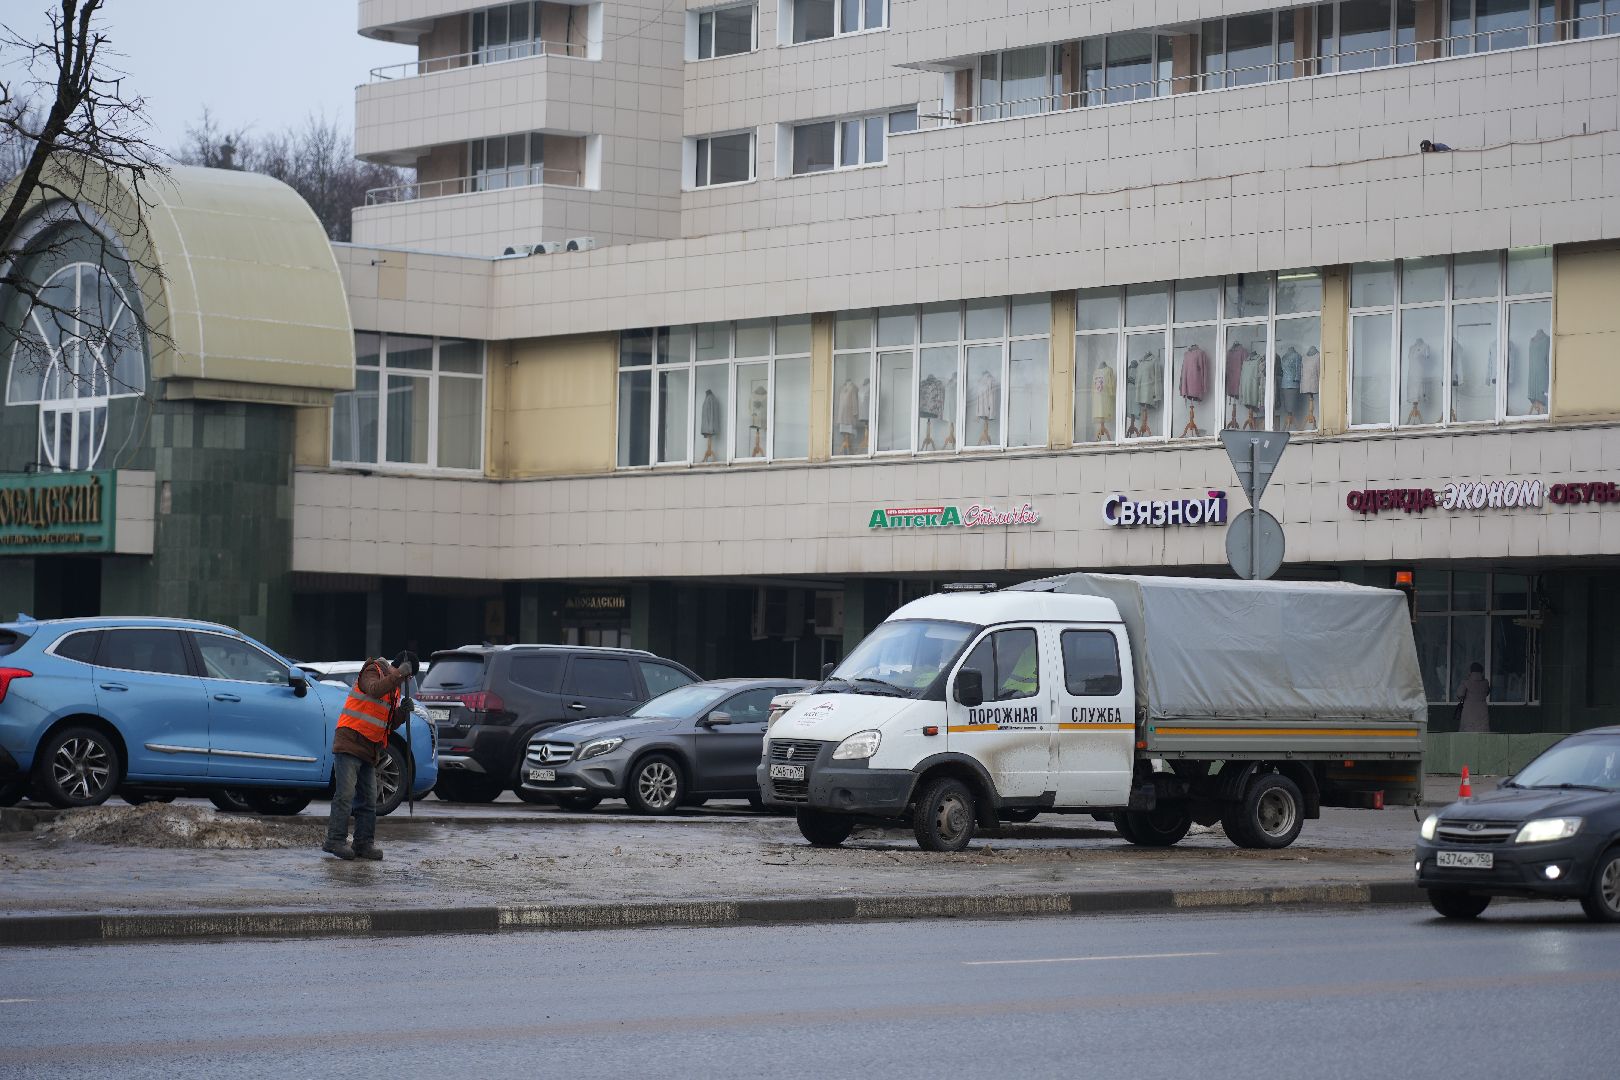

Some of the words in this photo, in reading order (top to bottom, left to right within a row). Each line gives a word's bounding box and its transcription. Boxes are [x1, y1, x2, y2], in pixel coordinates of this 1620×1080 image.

[1346, 488, 1437, 514] ОДЕЖДА
[1442, 479, 1544, 510] ЭКОНОМ
[969, 707, 1038, 725] ДОРОЖНАЯ
[1071, 706, 1122, 723] СЛУЖБА
